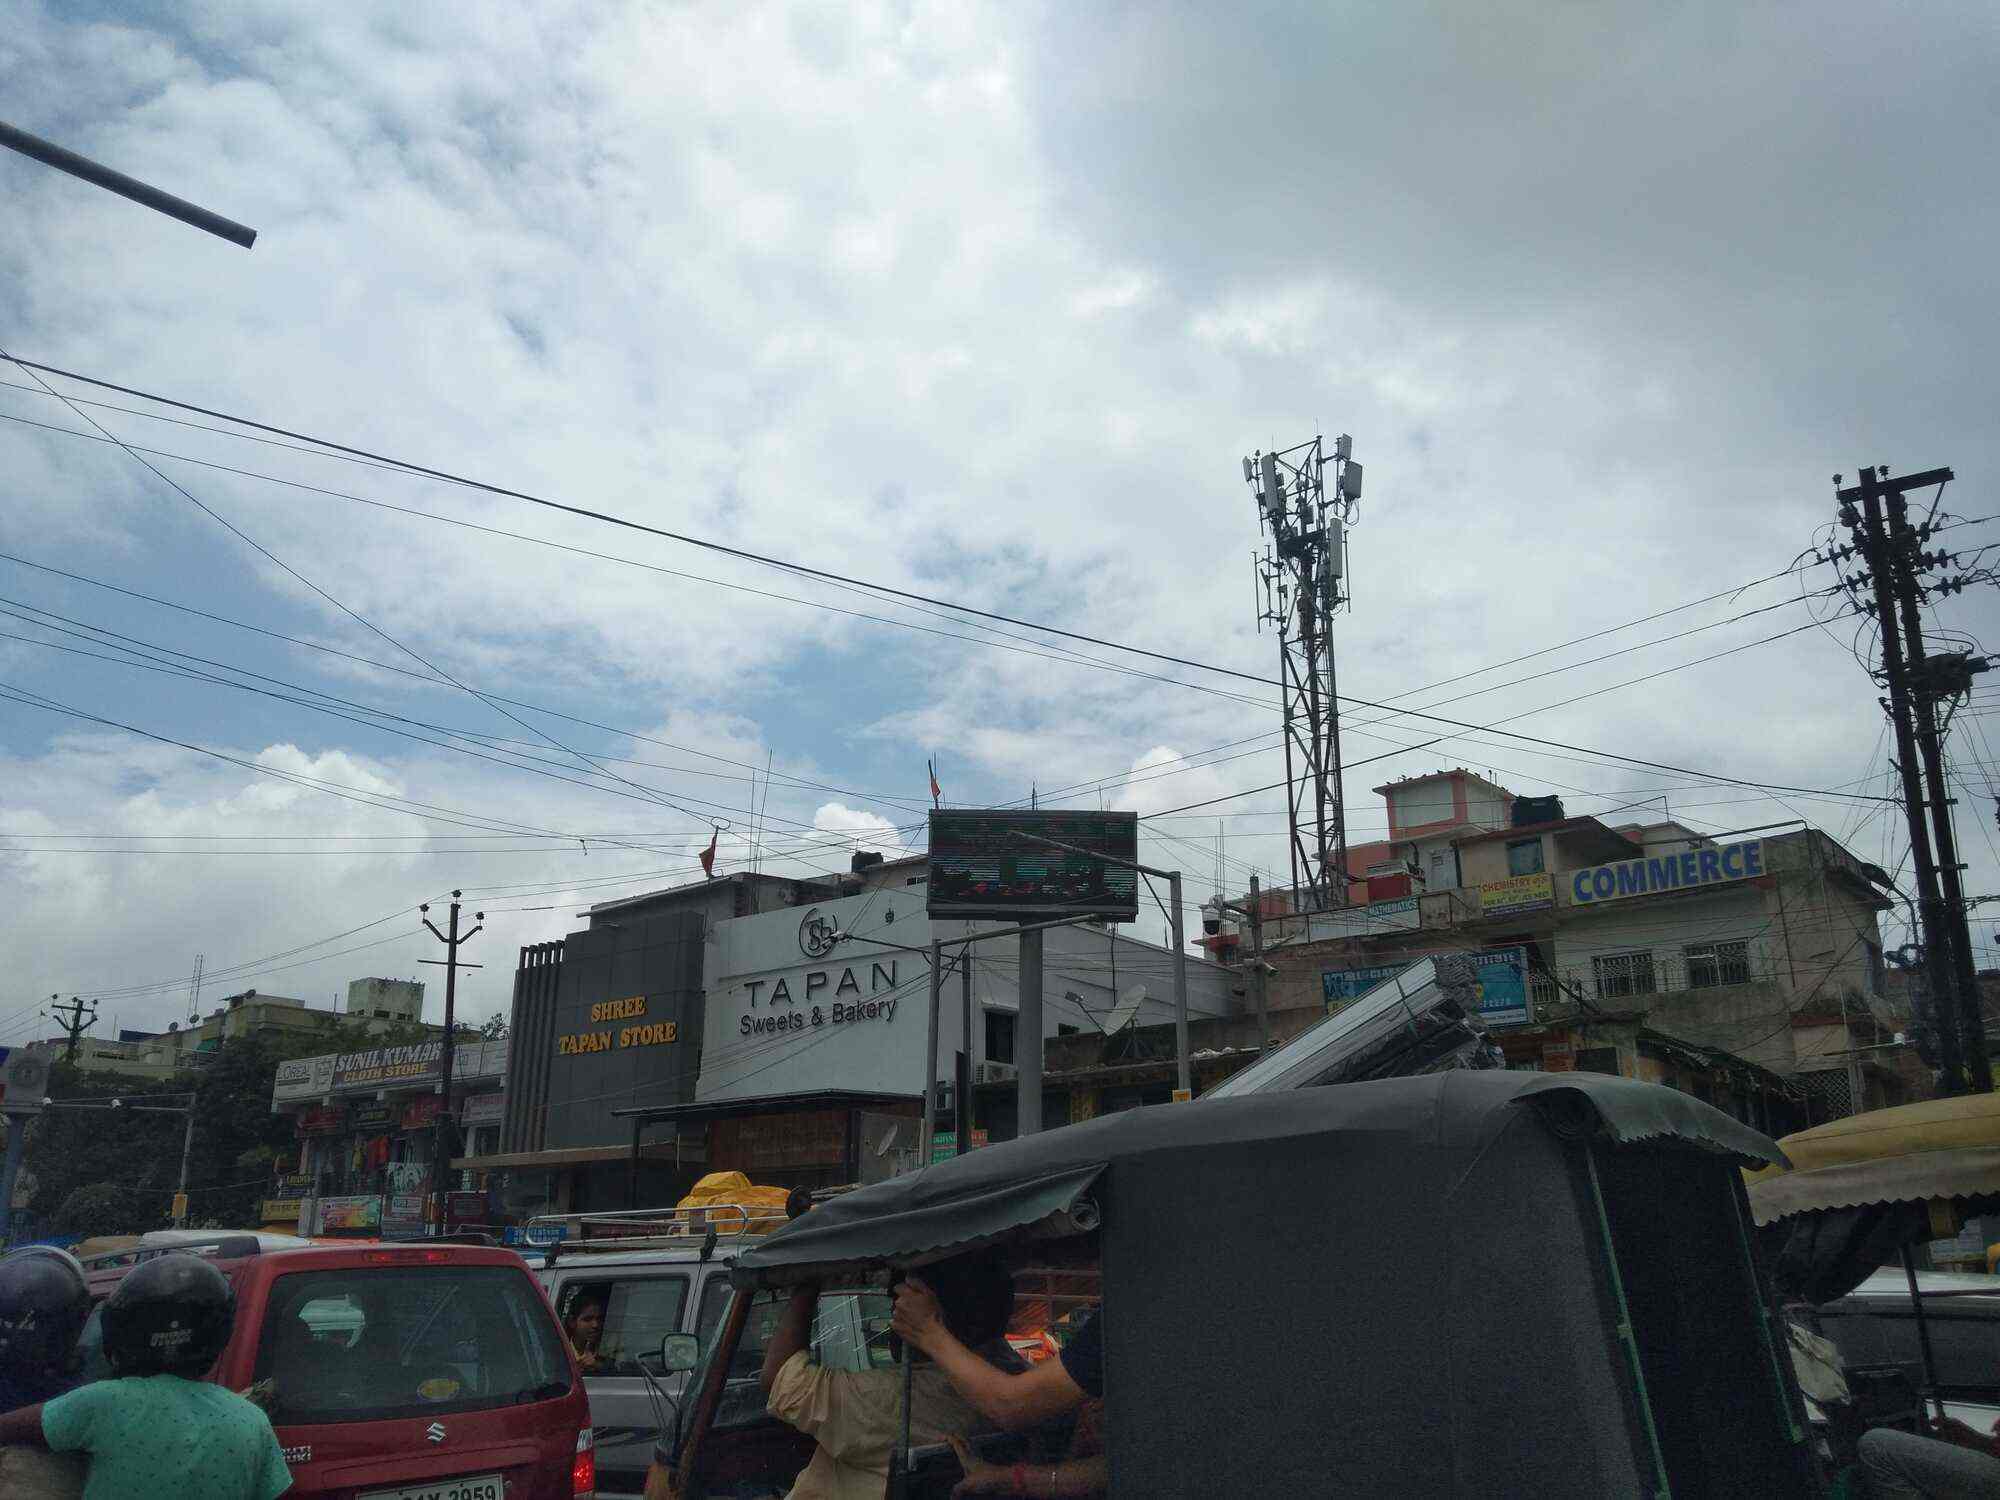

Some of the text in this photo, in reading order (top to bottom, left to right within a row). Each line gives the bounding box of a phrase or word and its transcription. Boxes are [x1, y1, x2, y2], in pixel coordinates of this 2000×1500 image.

[1574, 843, 1761, 901] COMMERCE
[743, 960, 896, 1008] TAPAN
[591, 996, 648, 1022] SHREE
[740, 999, 898, 1035] Sweets & Bakery
[559, 1021, 677, 1055] TAPAN STORE
[336, 1042, 442, 1072] SUNIL KUMAR
[344, 1067, 385, 1082] CLOTH
[386, 1062, 428, 1077] STORE
